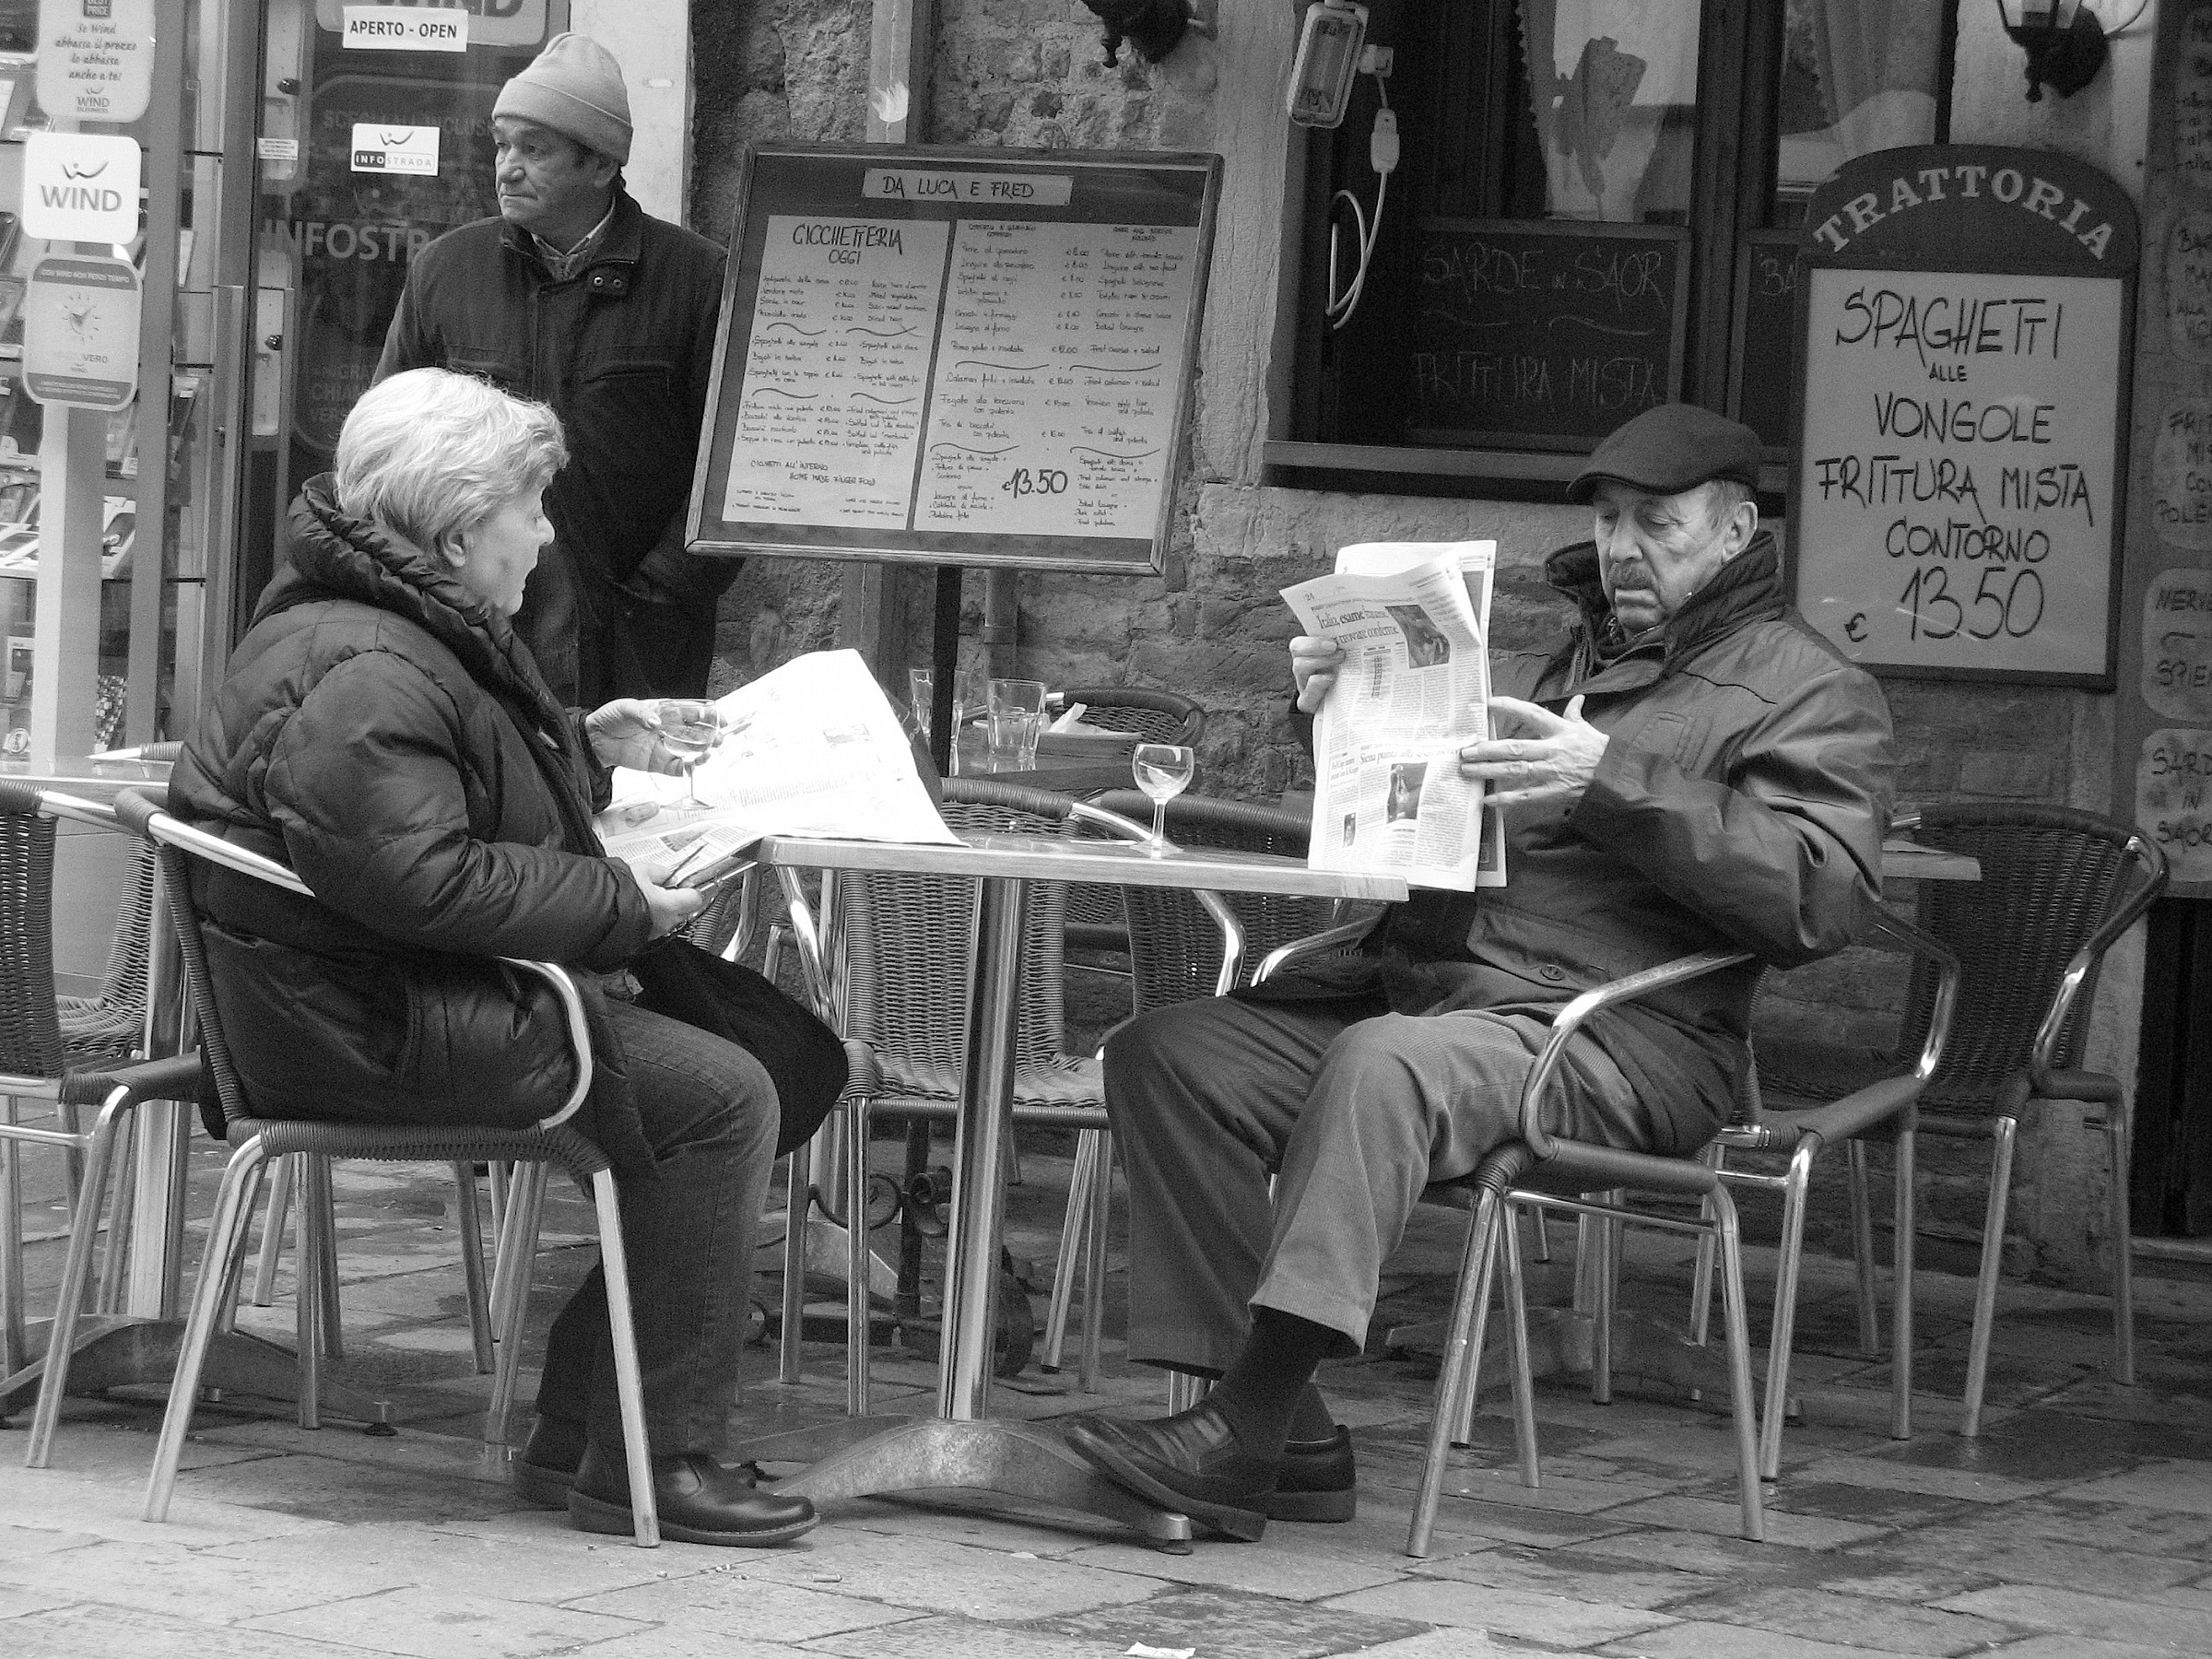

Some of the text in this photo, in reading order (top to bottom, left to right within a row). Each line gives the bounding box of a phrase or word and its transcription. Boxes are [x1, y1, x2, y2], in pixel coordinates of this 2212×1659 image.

[90, 22, 117, 34] Wind
[350, 20, 405, 37] APERTO
[418, 23, 457, 39] OPEN
[55, 36, 91, 49] abbassa
[83, 53, 120, 65] abbassa
[68, 68, 97, 80] anche
[76, 96, 110, 108] WIND
[41, 184, 123, 213] WIND
[882, 175, 1034, 199] DA LUCA E FRED
[1813, 165, 2114, 261] TRATTORIA
[793, 225, 903, 255] CICCHETTERIA
[829, 249, 861, 265] OGGI
[1424, 241, 1544, 304] SARDE
[1575, 244, 1666, 312] SAOR
[1836, 288, 2063, 368] SPAGHETTI
[83, 354, 109, 364] VERO
[1414, 350, 1658, 409] FRITTURA MISTA
[1929, 362, 1967, 382] ALLE
[1875, 392, 2055, 444] VONGOLE
[1816, 454, 2093, 526] FRITTURA MISTA
[2157, 500, 2212, 524] POLE
[1886, 517, 2050, 563] CONTORNO
[1339, 610, 1366, 624] esame
